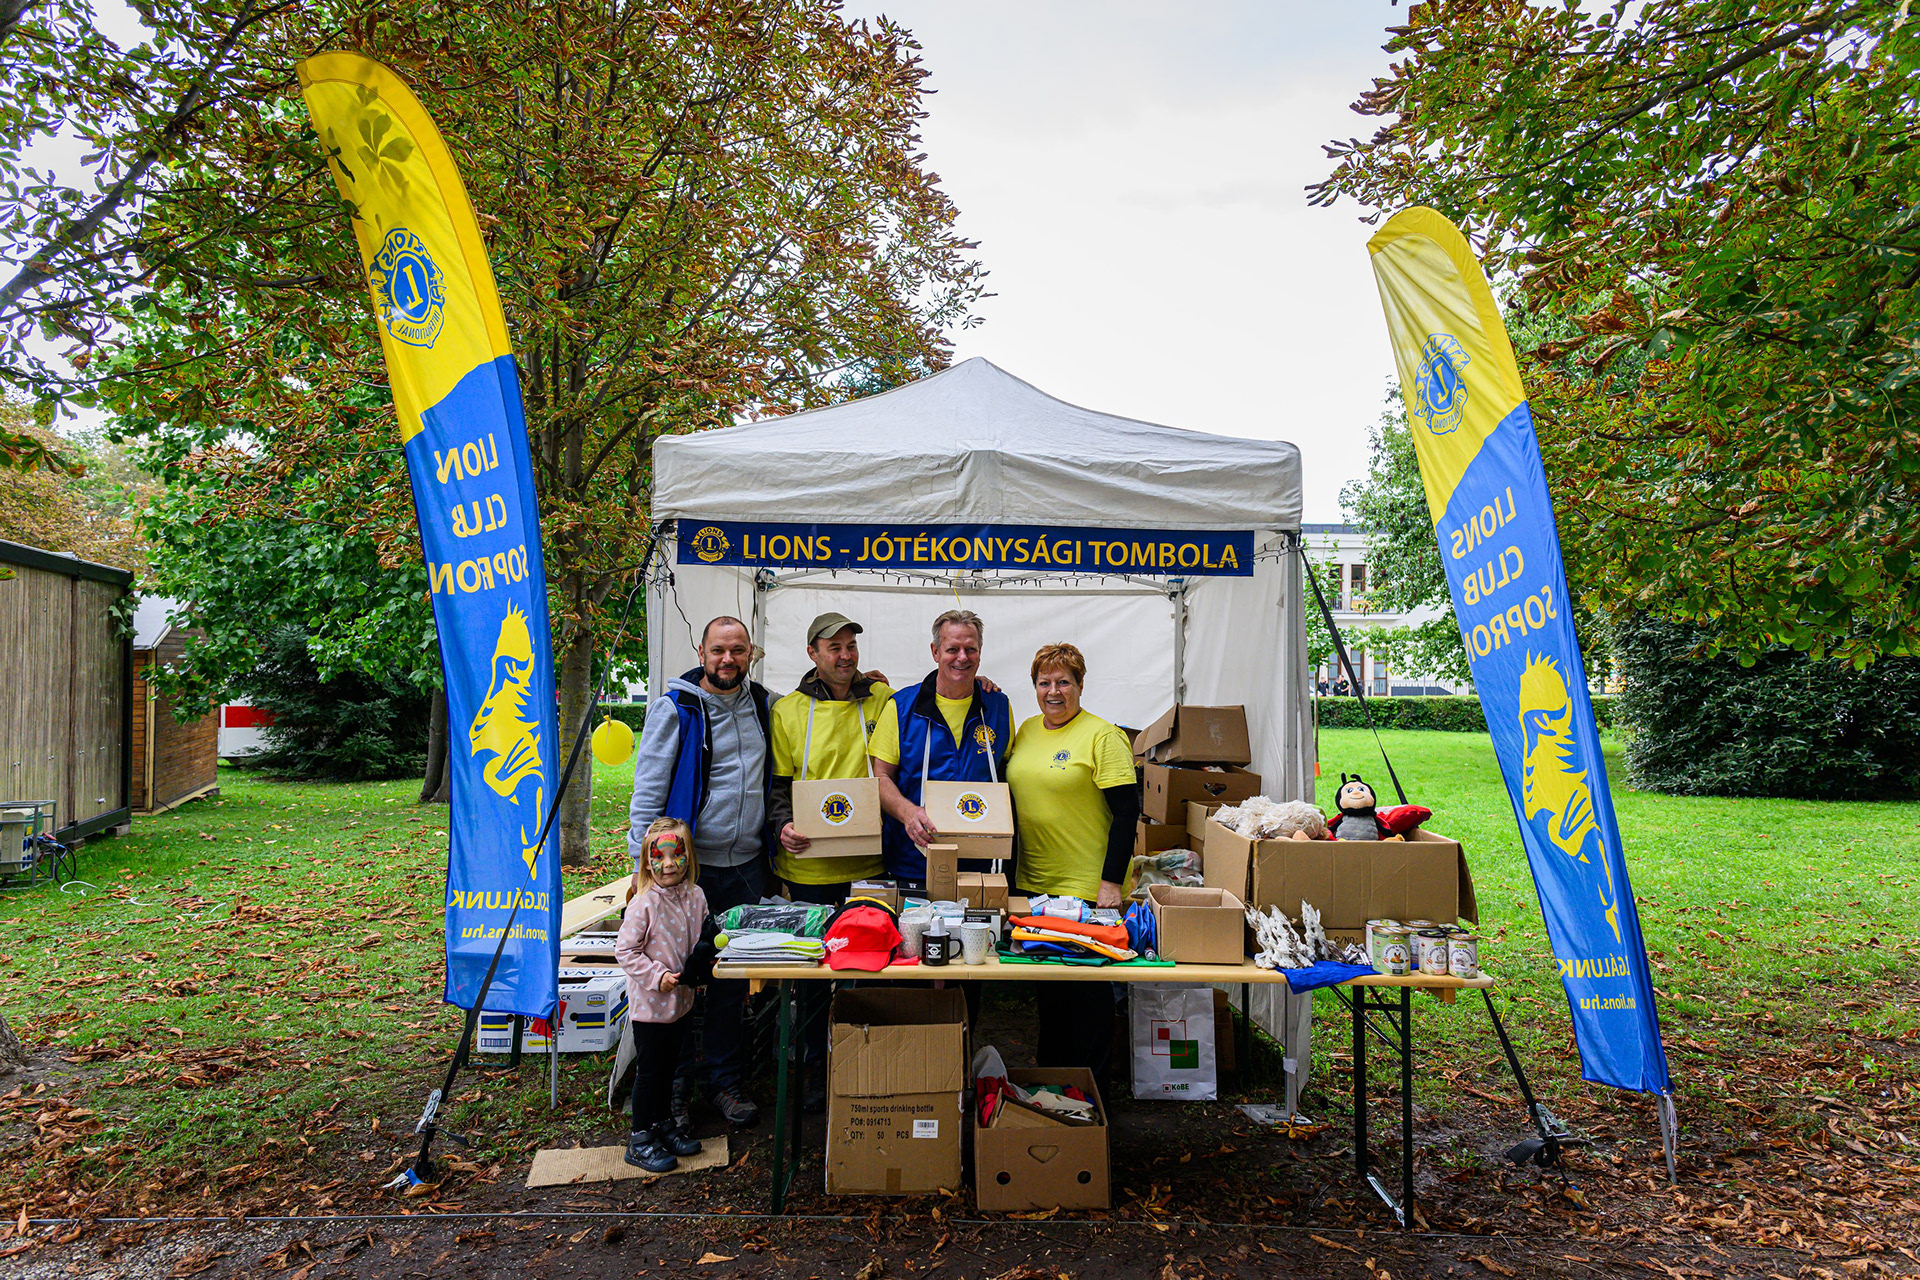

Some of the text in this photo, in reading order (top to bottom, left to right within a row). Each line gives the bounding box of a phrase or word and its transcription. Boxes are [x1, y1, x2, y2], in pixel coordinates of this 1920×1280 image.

[743, 534, 832, 561] LIONS
[856, 531, 1081, 565] JÓTÉKONYSÁGI
[1088, 541, 1239, 569] TOMBOLA
[851, 1103, 934, 1114] 750ml sports drinking bottle
[866, 1118, 891, 1126] 0914713
[850, 1131, 865, 1139] QTY:
[877, 1131, 884, 1139] 50
[896, 1131, 909, 1139] PCS
